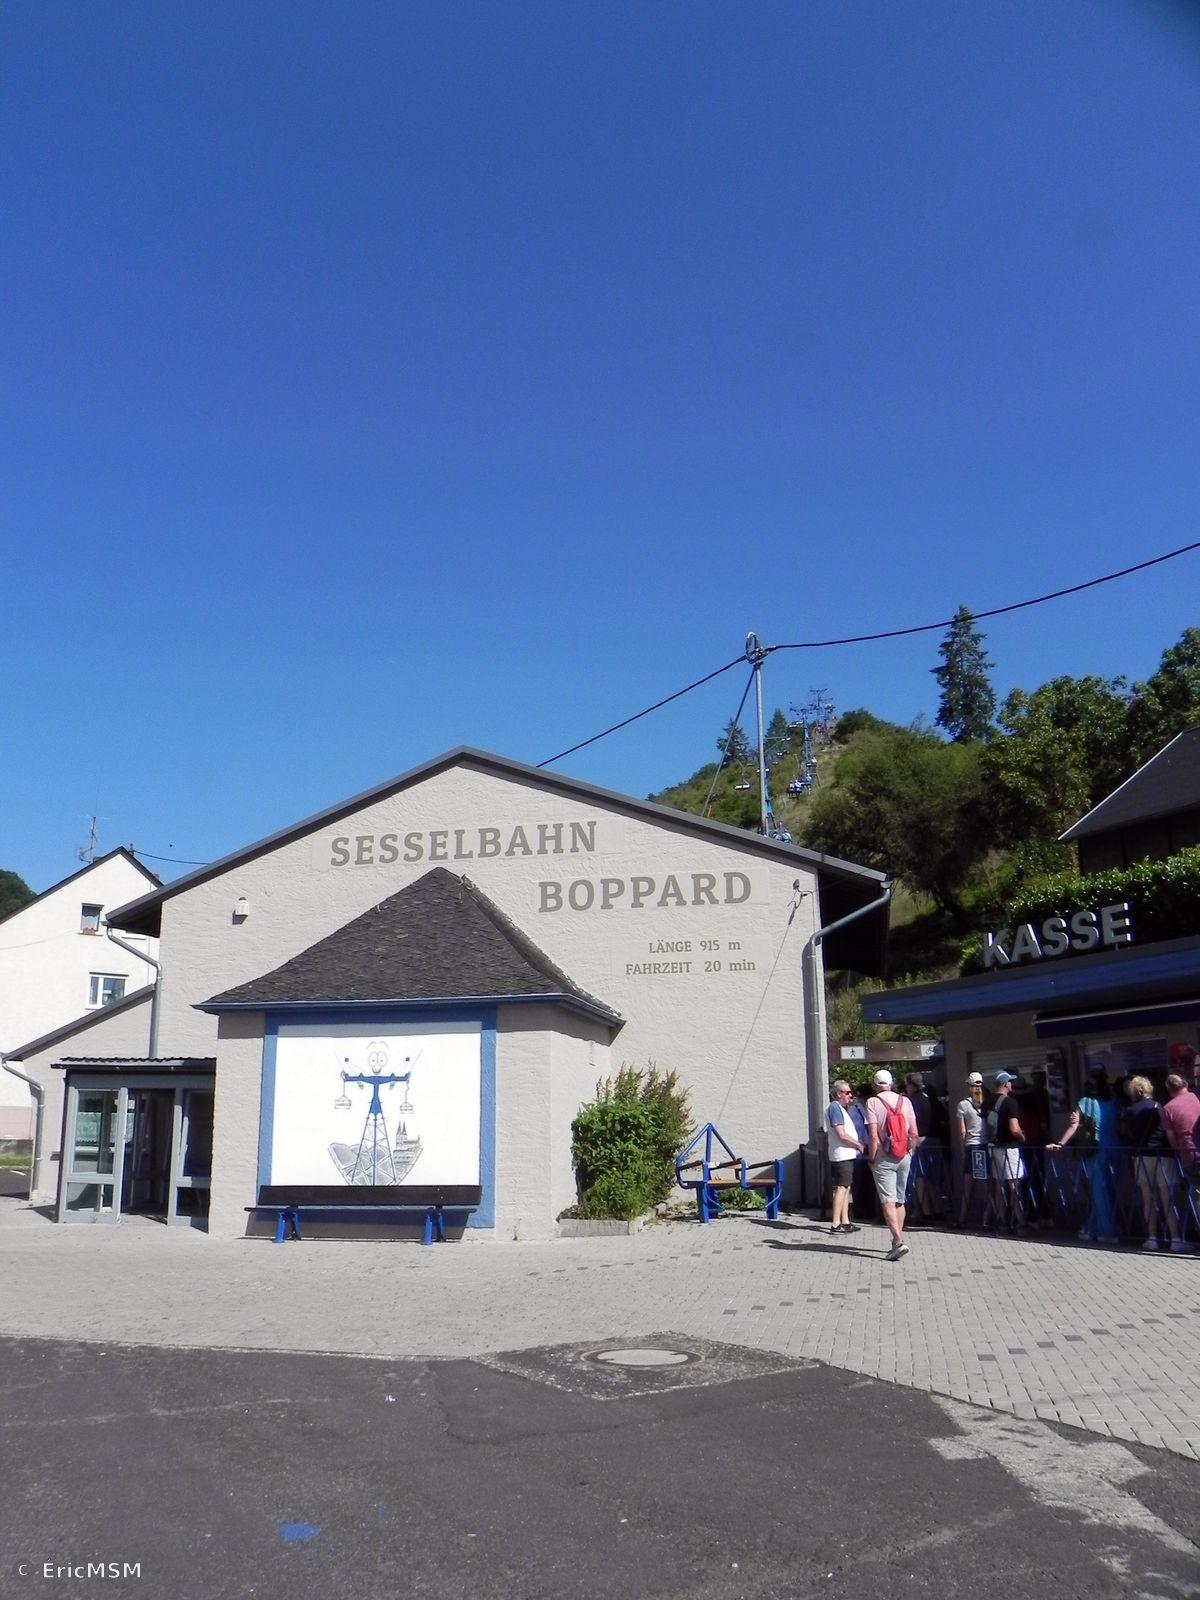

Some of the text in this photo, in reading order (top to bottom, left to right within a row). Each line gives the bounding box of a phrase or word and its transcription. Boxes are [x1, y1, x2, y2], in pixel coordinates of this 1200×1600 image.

[330, 820, 597, 866] SESSELBAHN
[538, 872, 752, 913] BOPPARD
[649, 940, 741, 953] LÄNGE 915 m
[983, 902, 1132, 968] KASSE
[625, 959, 756, 975] FAHRZEIT 20 min
